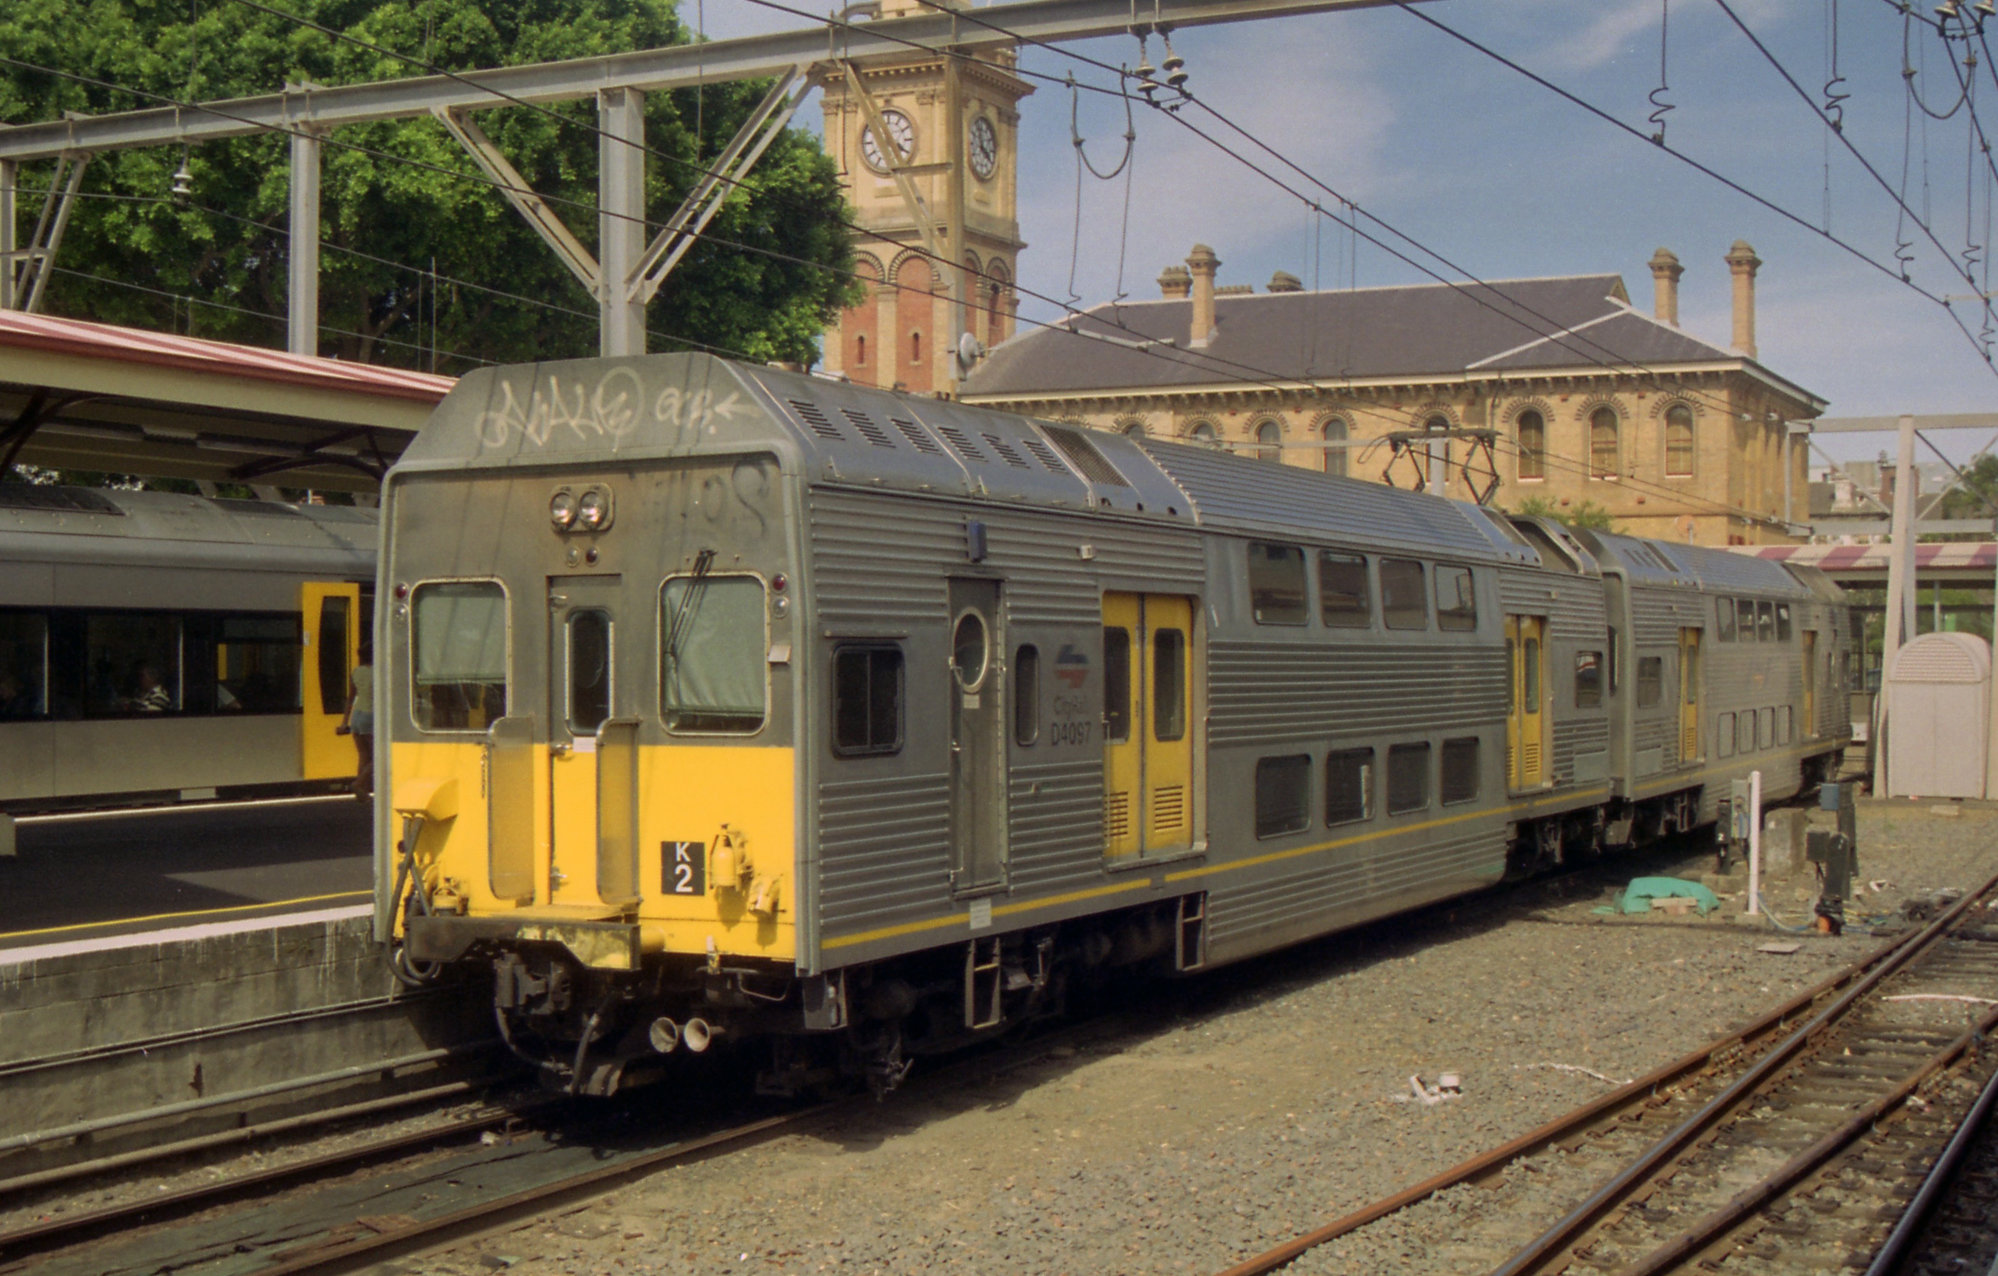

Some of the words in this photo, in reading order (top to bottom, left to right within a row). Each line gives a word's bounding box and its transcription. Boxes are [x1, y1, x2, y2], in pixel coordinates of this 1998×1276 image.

[1051, 721, 1092, 746] D4097
[674, 842, 692, 862] K
[674, 863, 693, 893] 2
